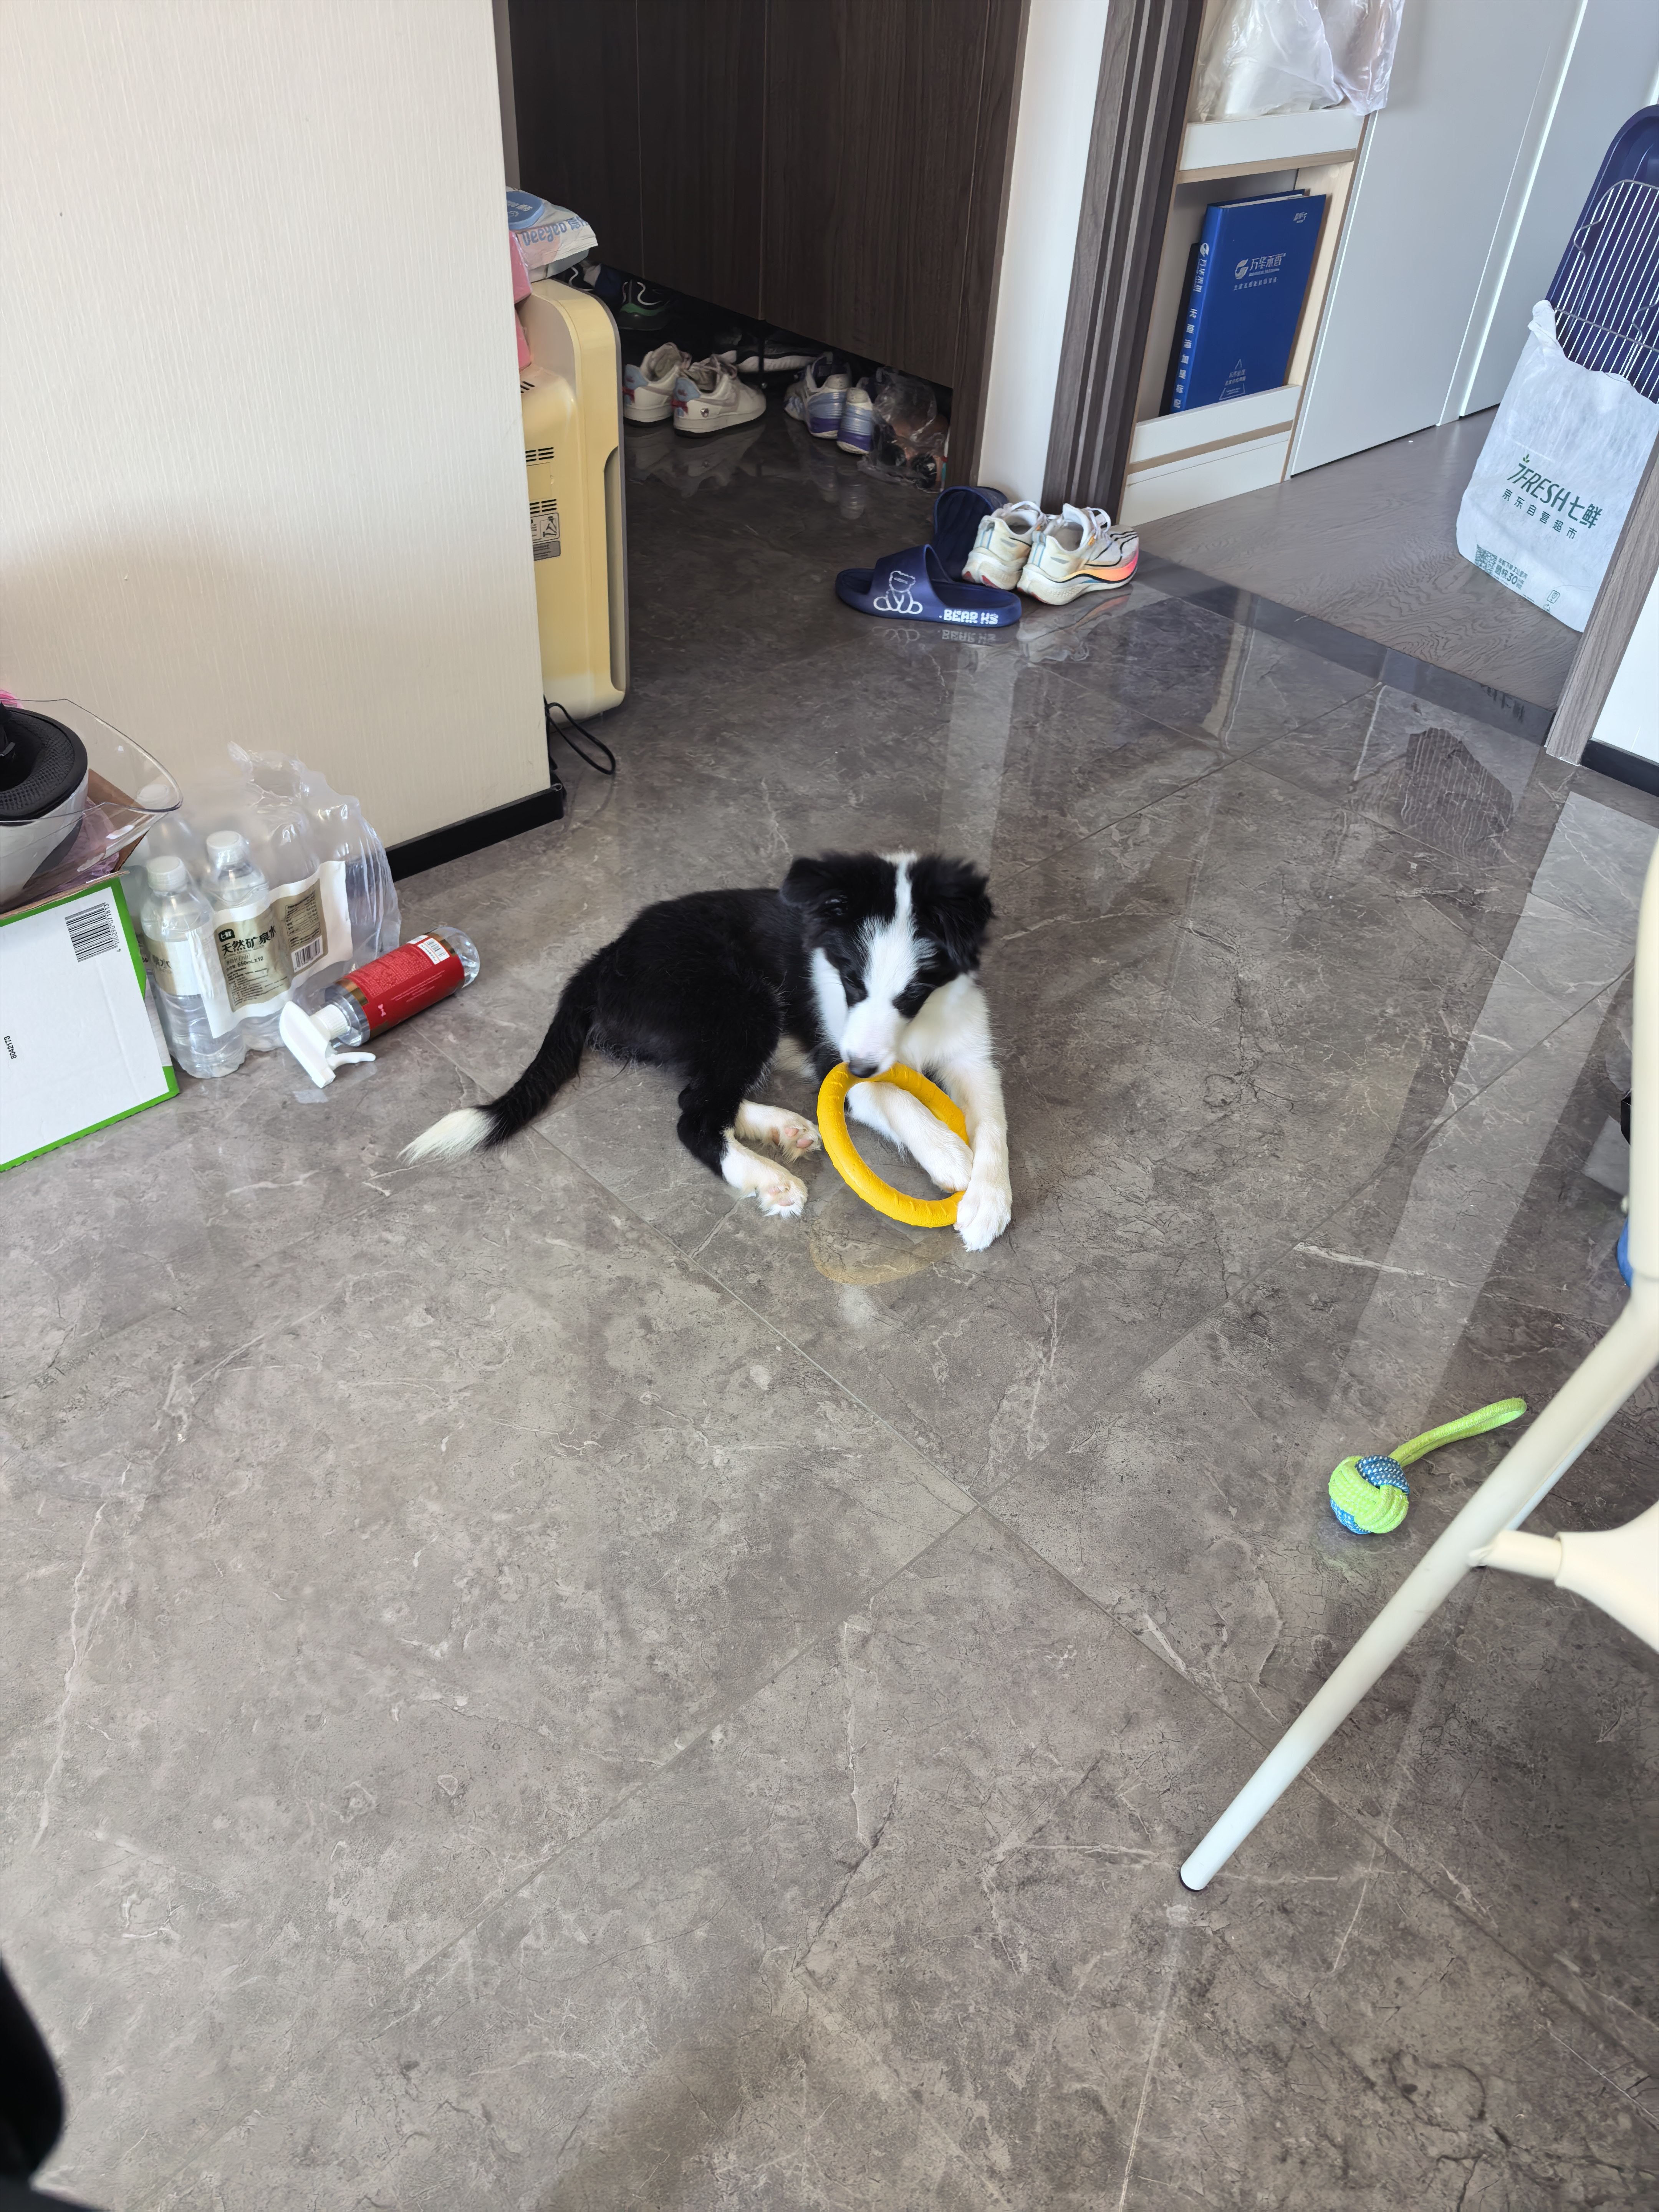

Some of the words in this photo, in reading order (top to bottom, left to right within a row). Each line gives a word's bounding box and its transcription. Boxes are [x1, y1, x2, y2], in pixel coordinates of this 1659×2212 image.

[1501, 488, 1577, 540] 京东自营超市
[1507, 463, 1571, 512] 7FRESH
[1568, 496, 1603, 529] 七鲜
[222, 926, 276, 957] 天然矿泉水
[4, 1035, 17, 1059] 8042173
